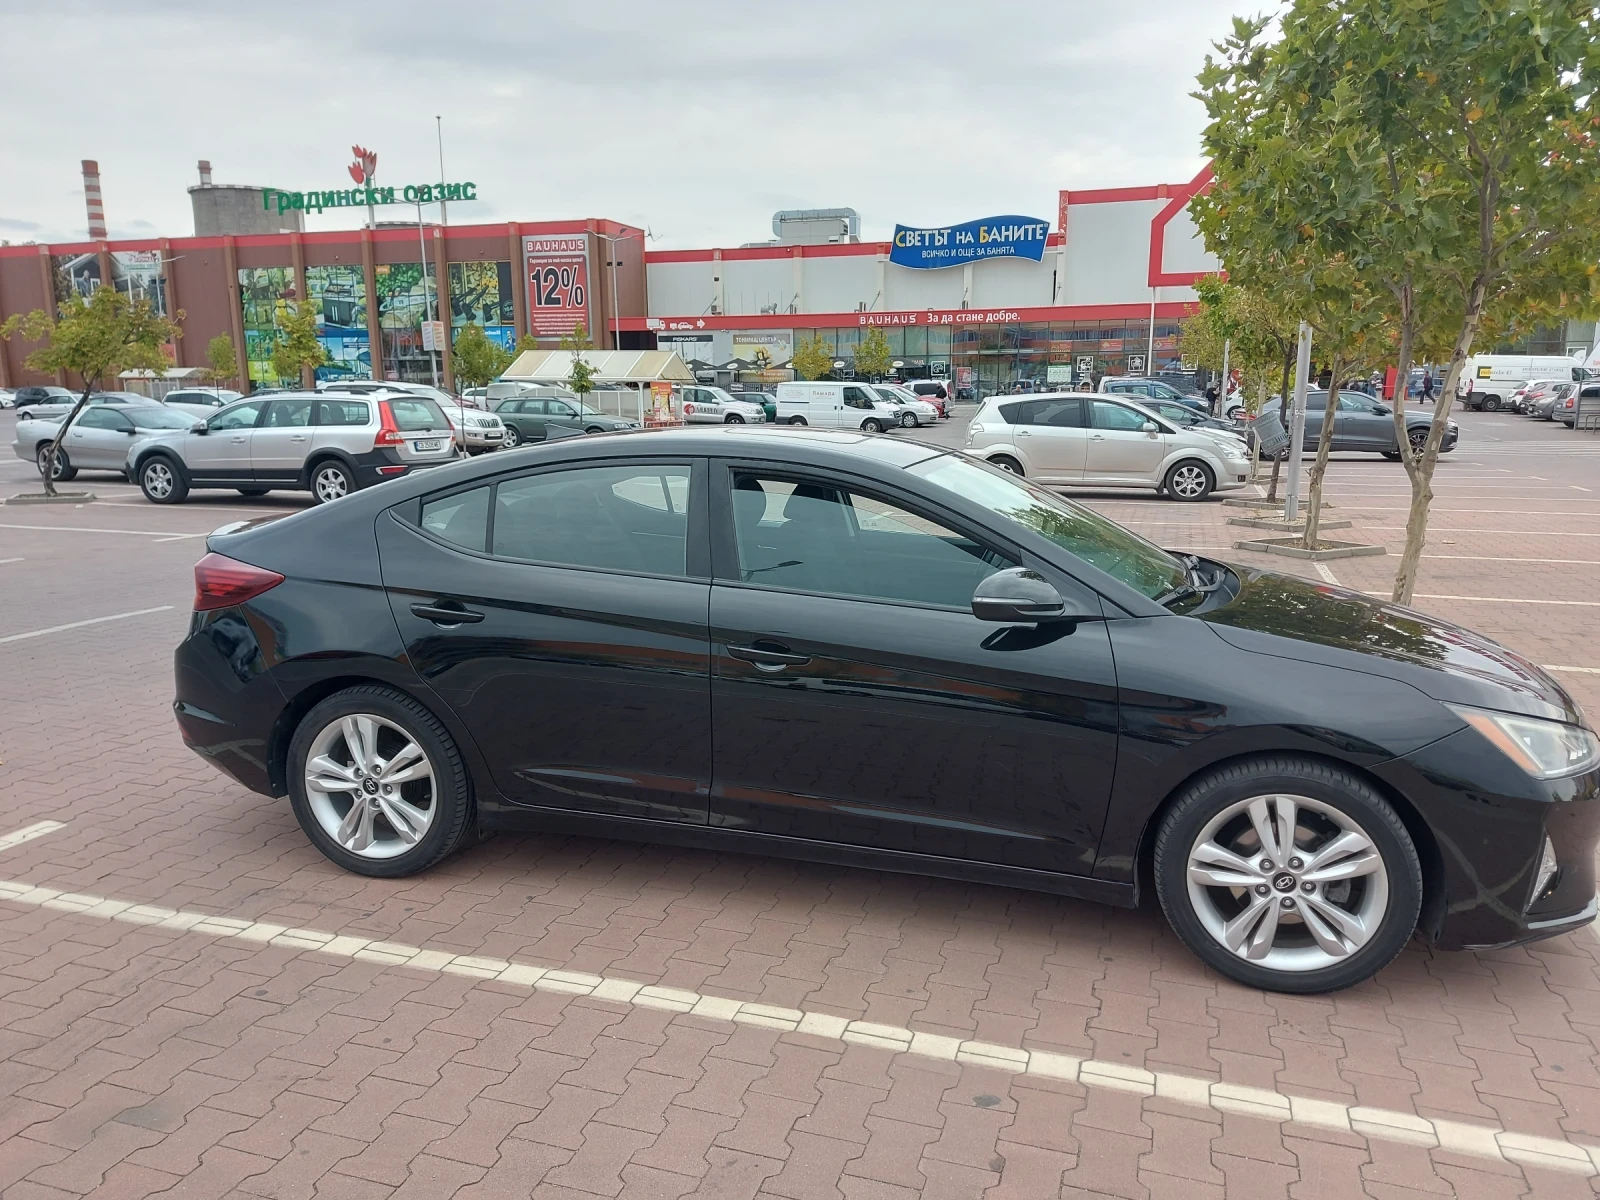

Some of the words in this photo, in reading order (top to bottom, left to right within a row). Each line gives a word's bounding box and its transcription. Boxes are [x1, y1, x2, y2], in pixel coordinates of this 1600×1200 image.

[262, 186, 396, 216] Градински
[403, 182, 477, 202] оазис
[895, 229, 952, 247] СВЕТЪТ
[527, 240, 584, 251] BAUHAUS
[921, 250, 950, 258] ВСИЧКО
[950, 249, 956, 257] И
[957, 248, 975, 258] ОЩЕ
[976, 247, 986, 255] ЗА
[986, 246, 1015, 255] БАНЯТА
[531, 265, 585, 308] 12%
[859, 313, 917, 325] BAUHAUS
[927, 312, 939, 323] За
[940, 314, 953, 324] да
[956, 313, 984, 322] стане
[985, 310, 1021, 323] добре.
